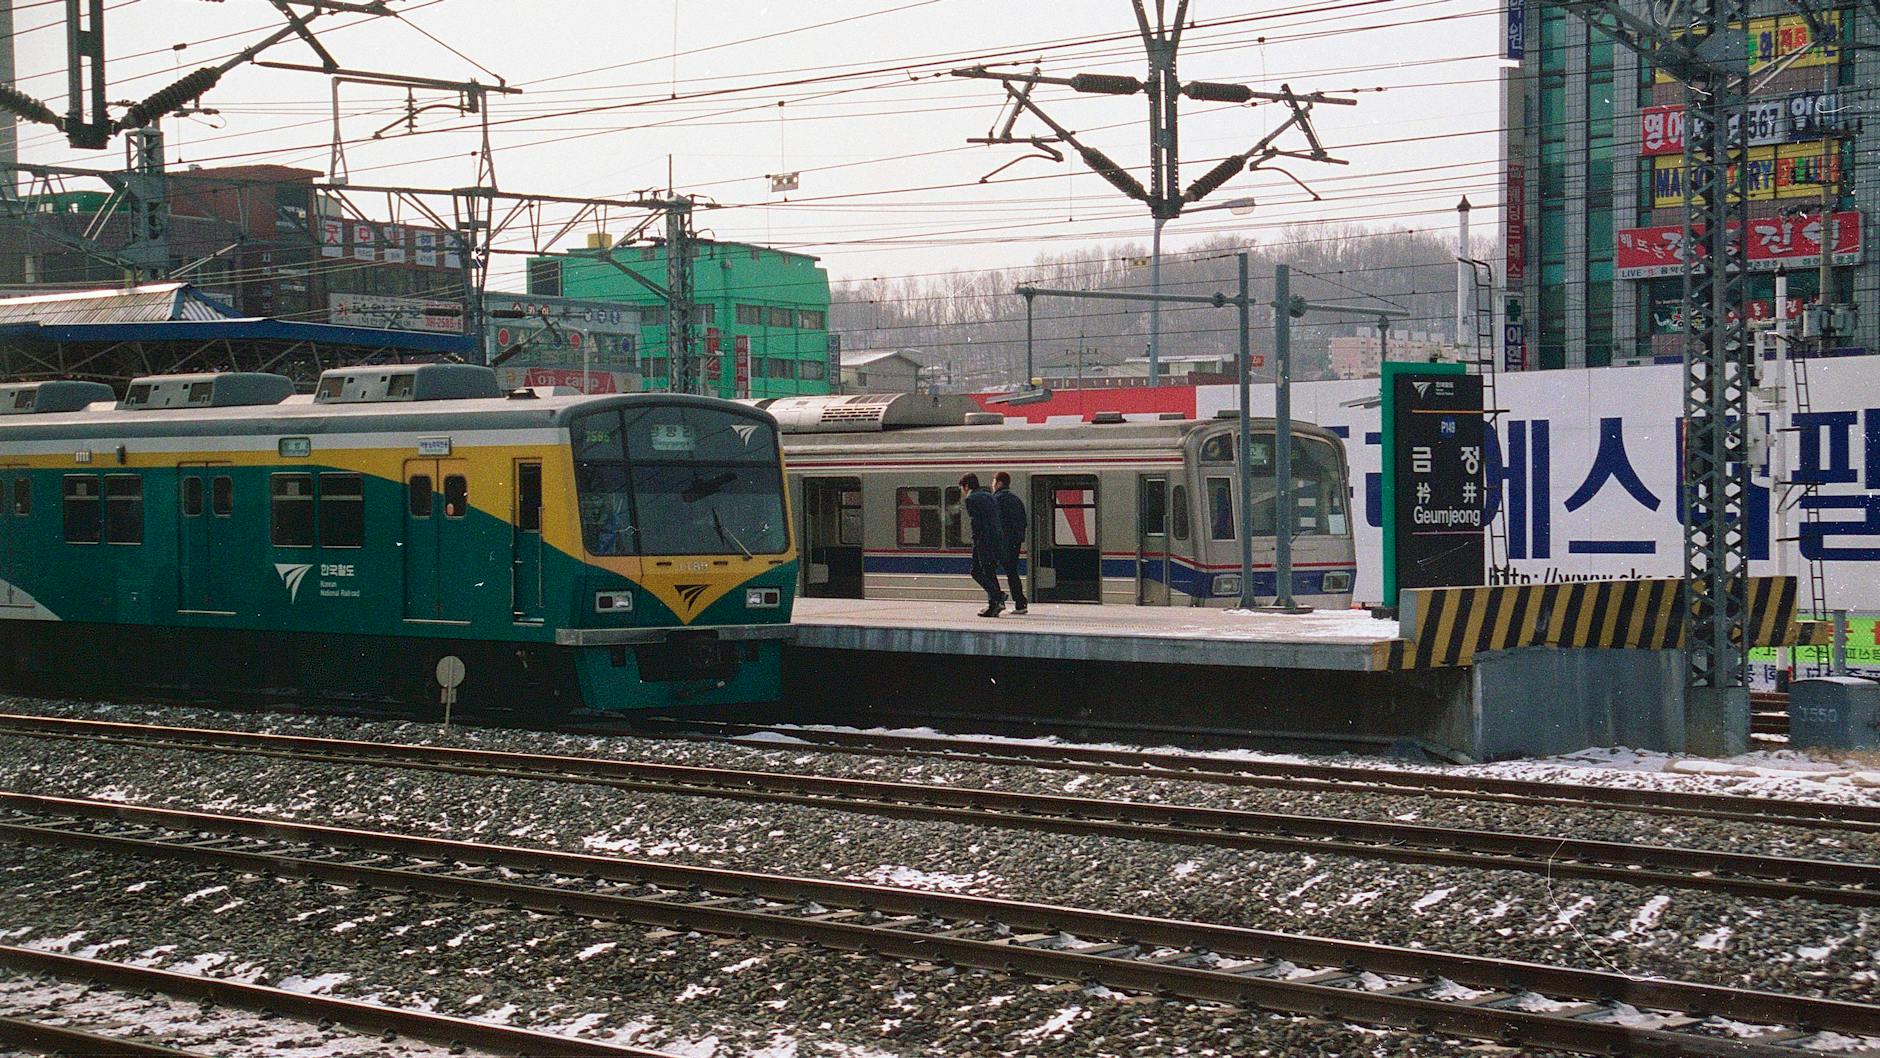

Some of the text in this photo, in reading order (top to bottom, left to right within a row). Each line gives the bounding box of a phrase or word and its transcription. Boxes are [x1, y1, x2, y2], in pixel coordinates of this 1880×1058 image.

[1621, 269, 1642, 278] LIVE
[1413, 506, 1481, 527] Geumjeong
[320, 564, 355, 577] 한국철도
